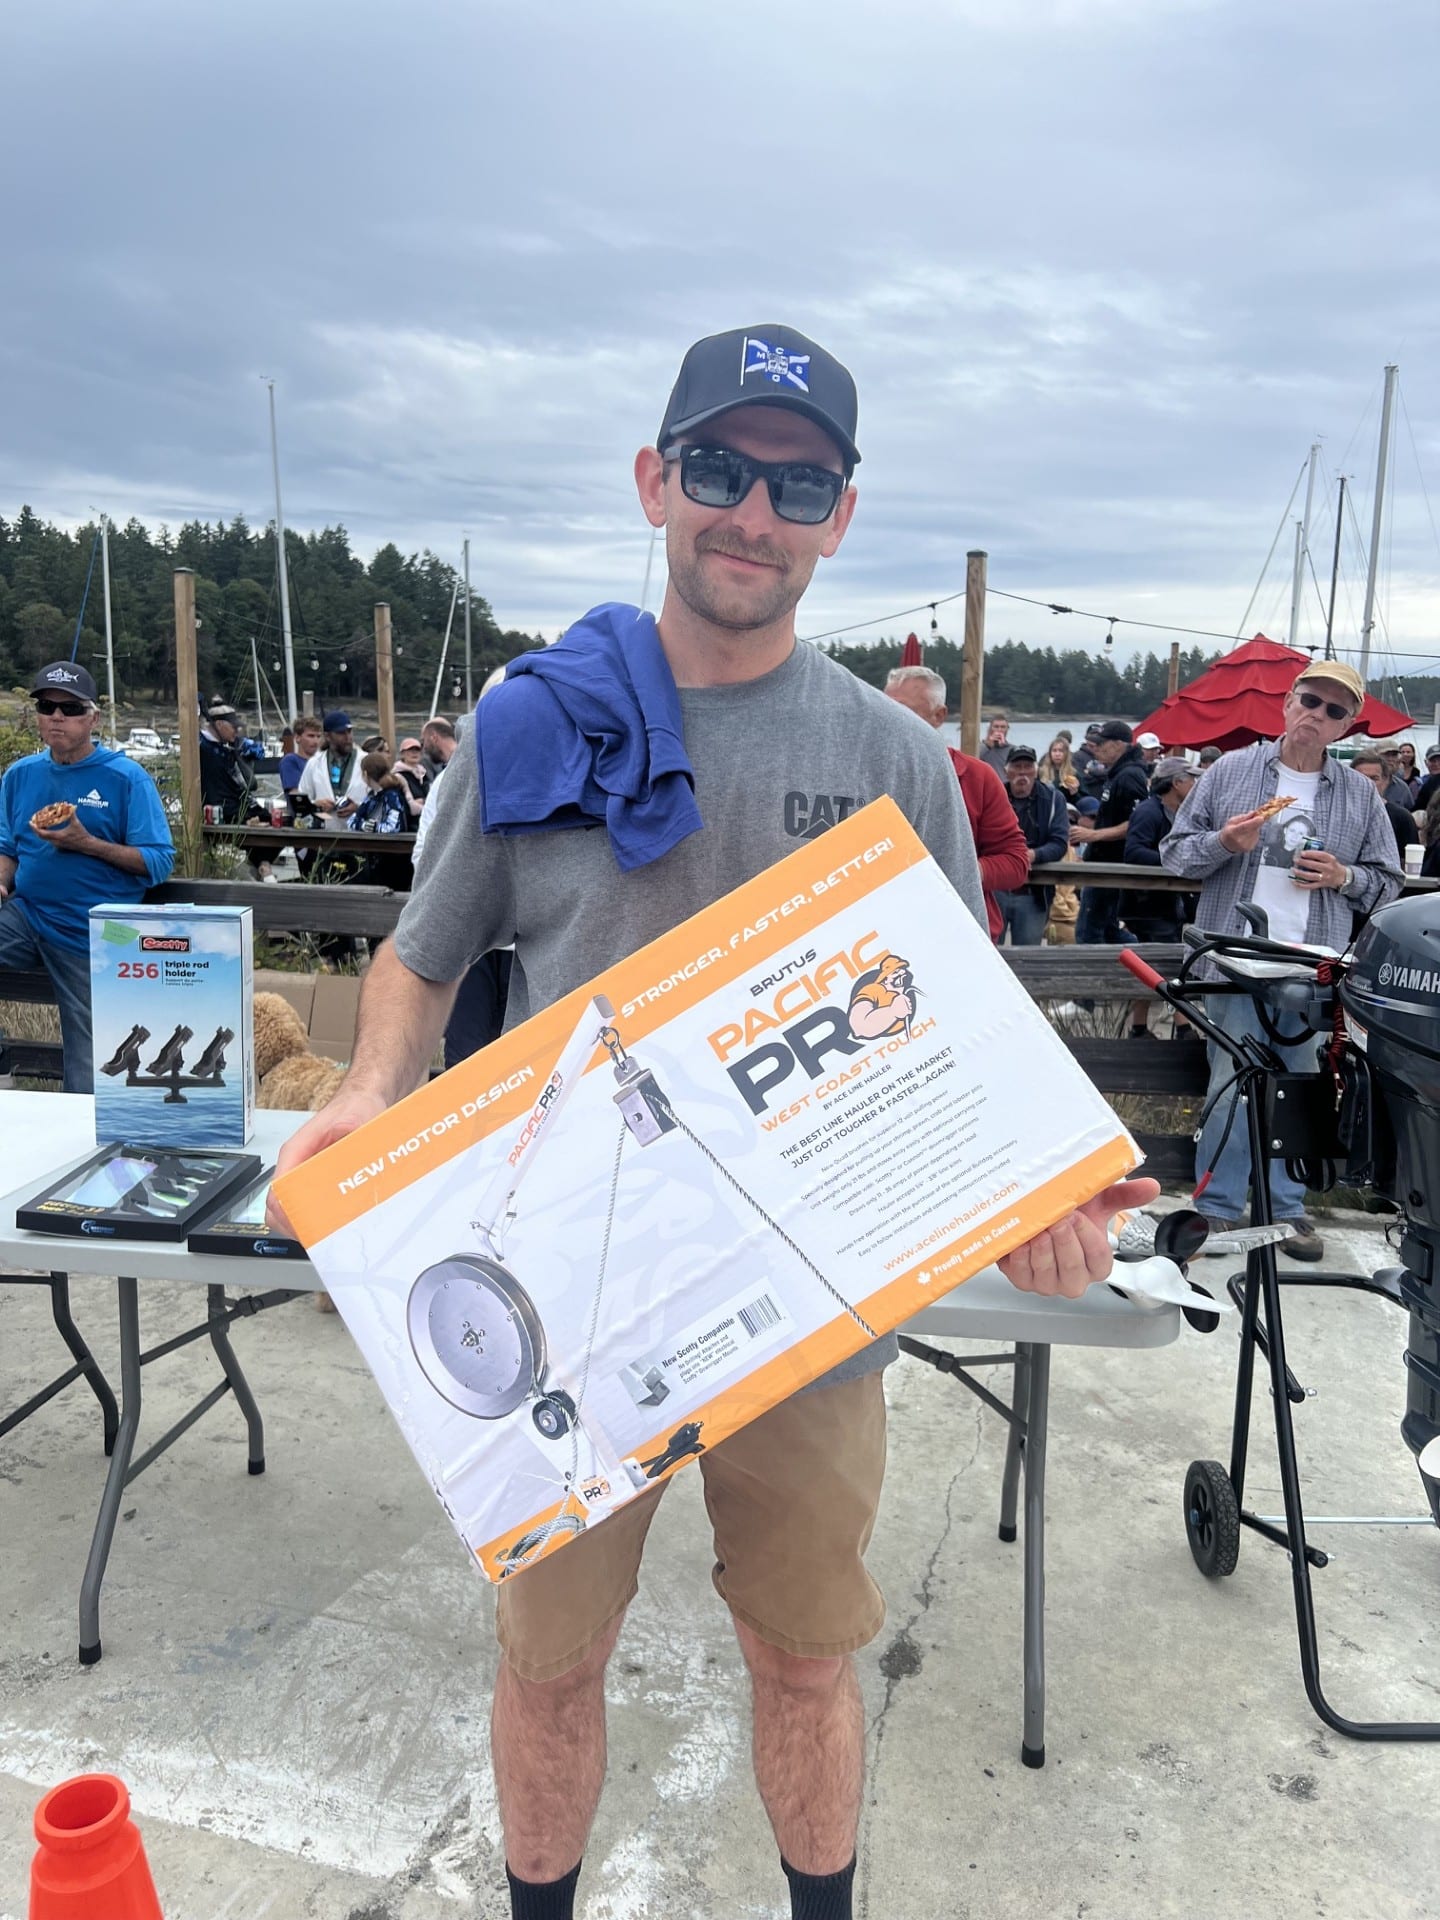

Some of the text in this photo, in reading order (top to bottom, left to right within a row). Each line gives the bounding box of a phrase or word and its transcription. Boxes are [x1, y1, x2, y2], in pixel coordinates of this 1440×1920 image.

[756, 351, 766, 359] M
[796, 366, 803, 375] S
[143, 937, 188, 951] Scotty
[618, 836, 896, 1019] STRONGER, FASTER, BETTER!
[117, 961, 159, 979] 256
[165, 960, 209, 969] triple rod
[165, 969, 196, 977] holder
[748, 947, 819, 997] BRUTUS
[704, 929, 892, 1063] PACIFIC
[760, 1015, 937, 1133] WEST COAST TOUGH
[822, 1063, 892, 1111] BY ACE LINE HAULER
[779, 1045, 954, 1160] THE BEST LINE HAULER ON THE MARKET
[336, 1064, 535, 1195] NEW MOTOR DESIGN
[790, 1149, 815, 1168] JUST
[813, 1136, 835, 1154] GOT
[833, 1108, 879, 1141] TOUGHER
[877, 1103, 886, 1113] &
[881, 1179, 1020, 1272] www.acelinehauler.com
[931, 1214, 1021, 1277] Proudly made in Canada
[661, 1353, 678, 1368] New
[675, 1340, 699, 1359] Scotty
[696, 1316, 736, 1345] Compatible
